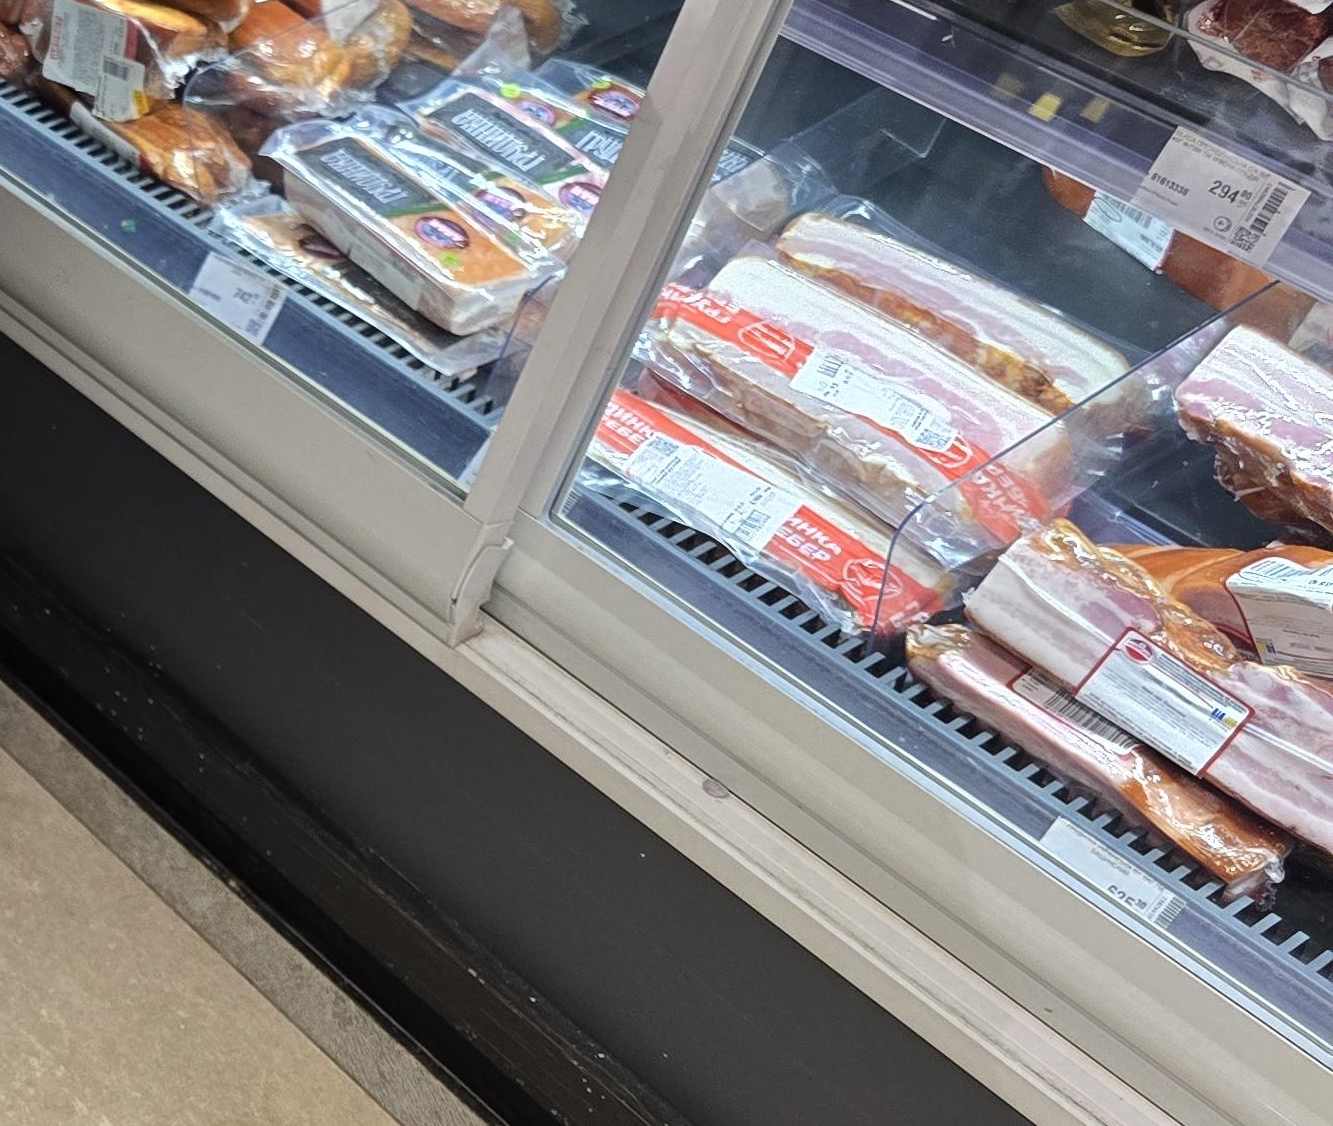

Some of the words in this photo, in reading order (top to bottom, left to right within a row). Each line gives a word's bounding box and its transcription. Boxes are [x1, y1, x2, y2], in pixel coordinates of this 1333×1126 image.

[451, 109, 546, 172] ГРУДИНКА
[320, 148, 409, 204] ГРУДИНКА
[1208, 179, 1240, 204] 294
